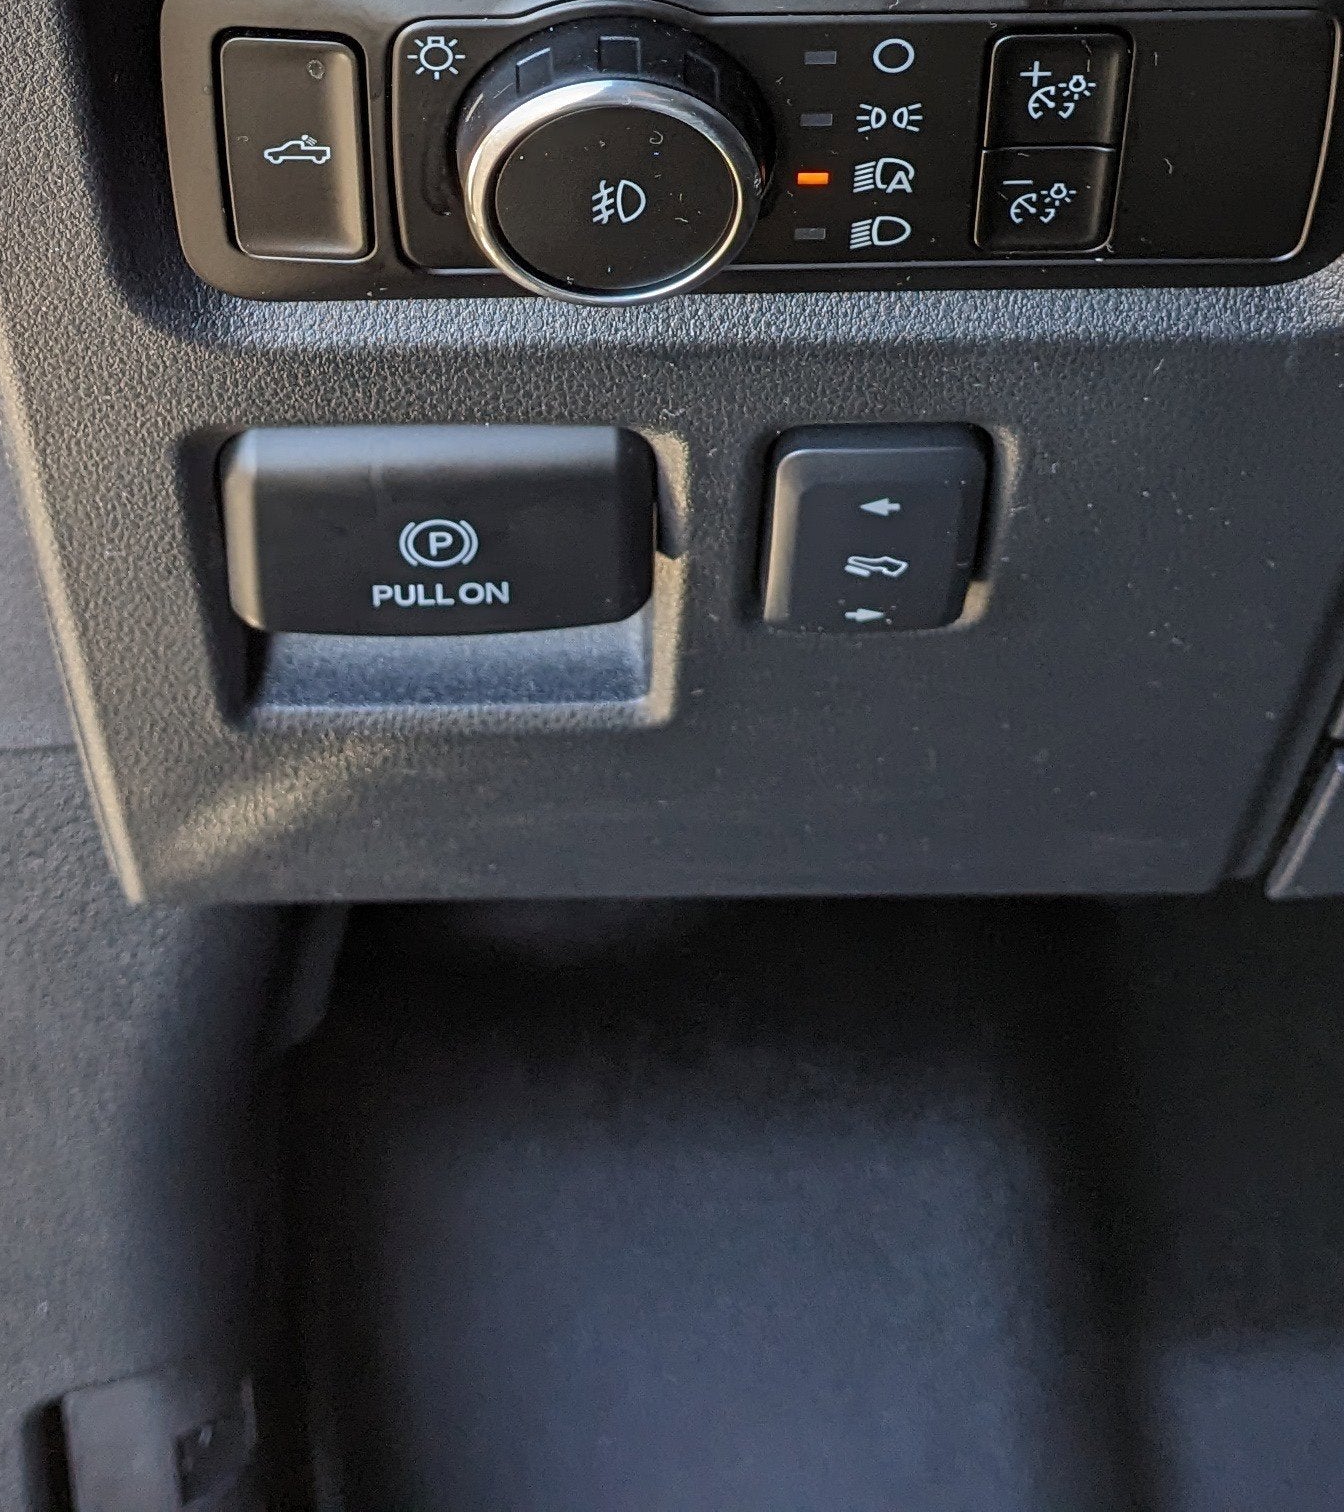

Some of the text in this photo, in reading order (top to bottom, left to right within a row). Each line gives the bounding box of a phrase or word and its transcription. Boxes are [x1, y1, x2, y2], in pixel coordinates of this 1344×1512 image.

[429, 531, 454, 557] P
[372, 581, 510, 607] PULL ON
